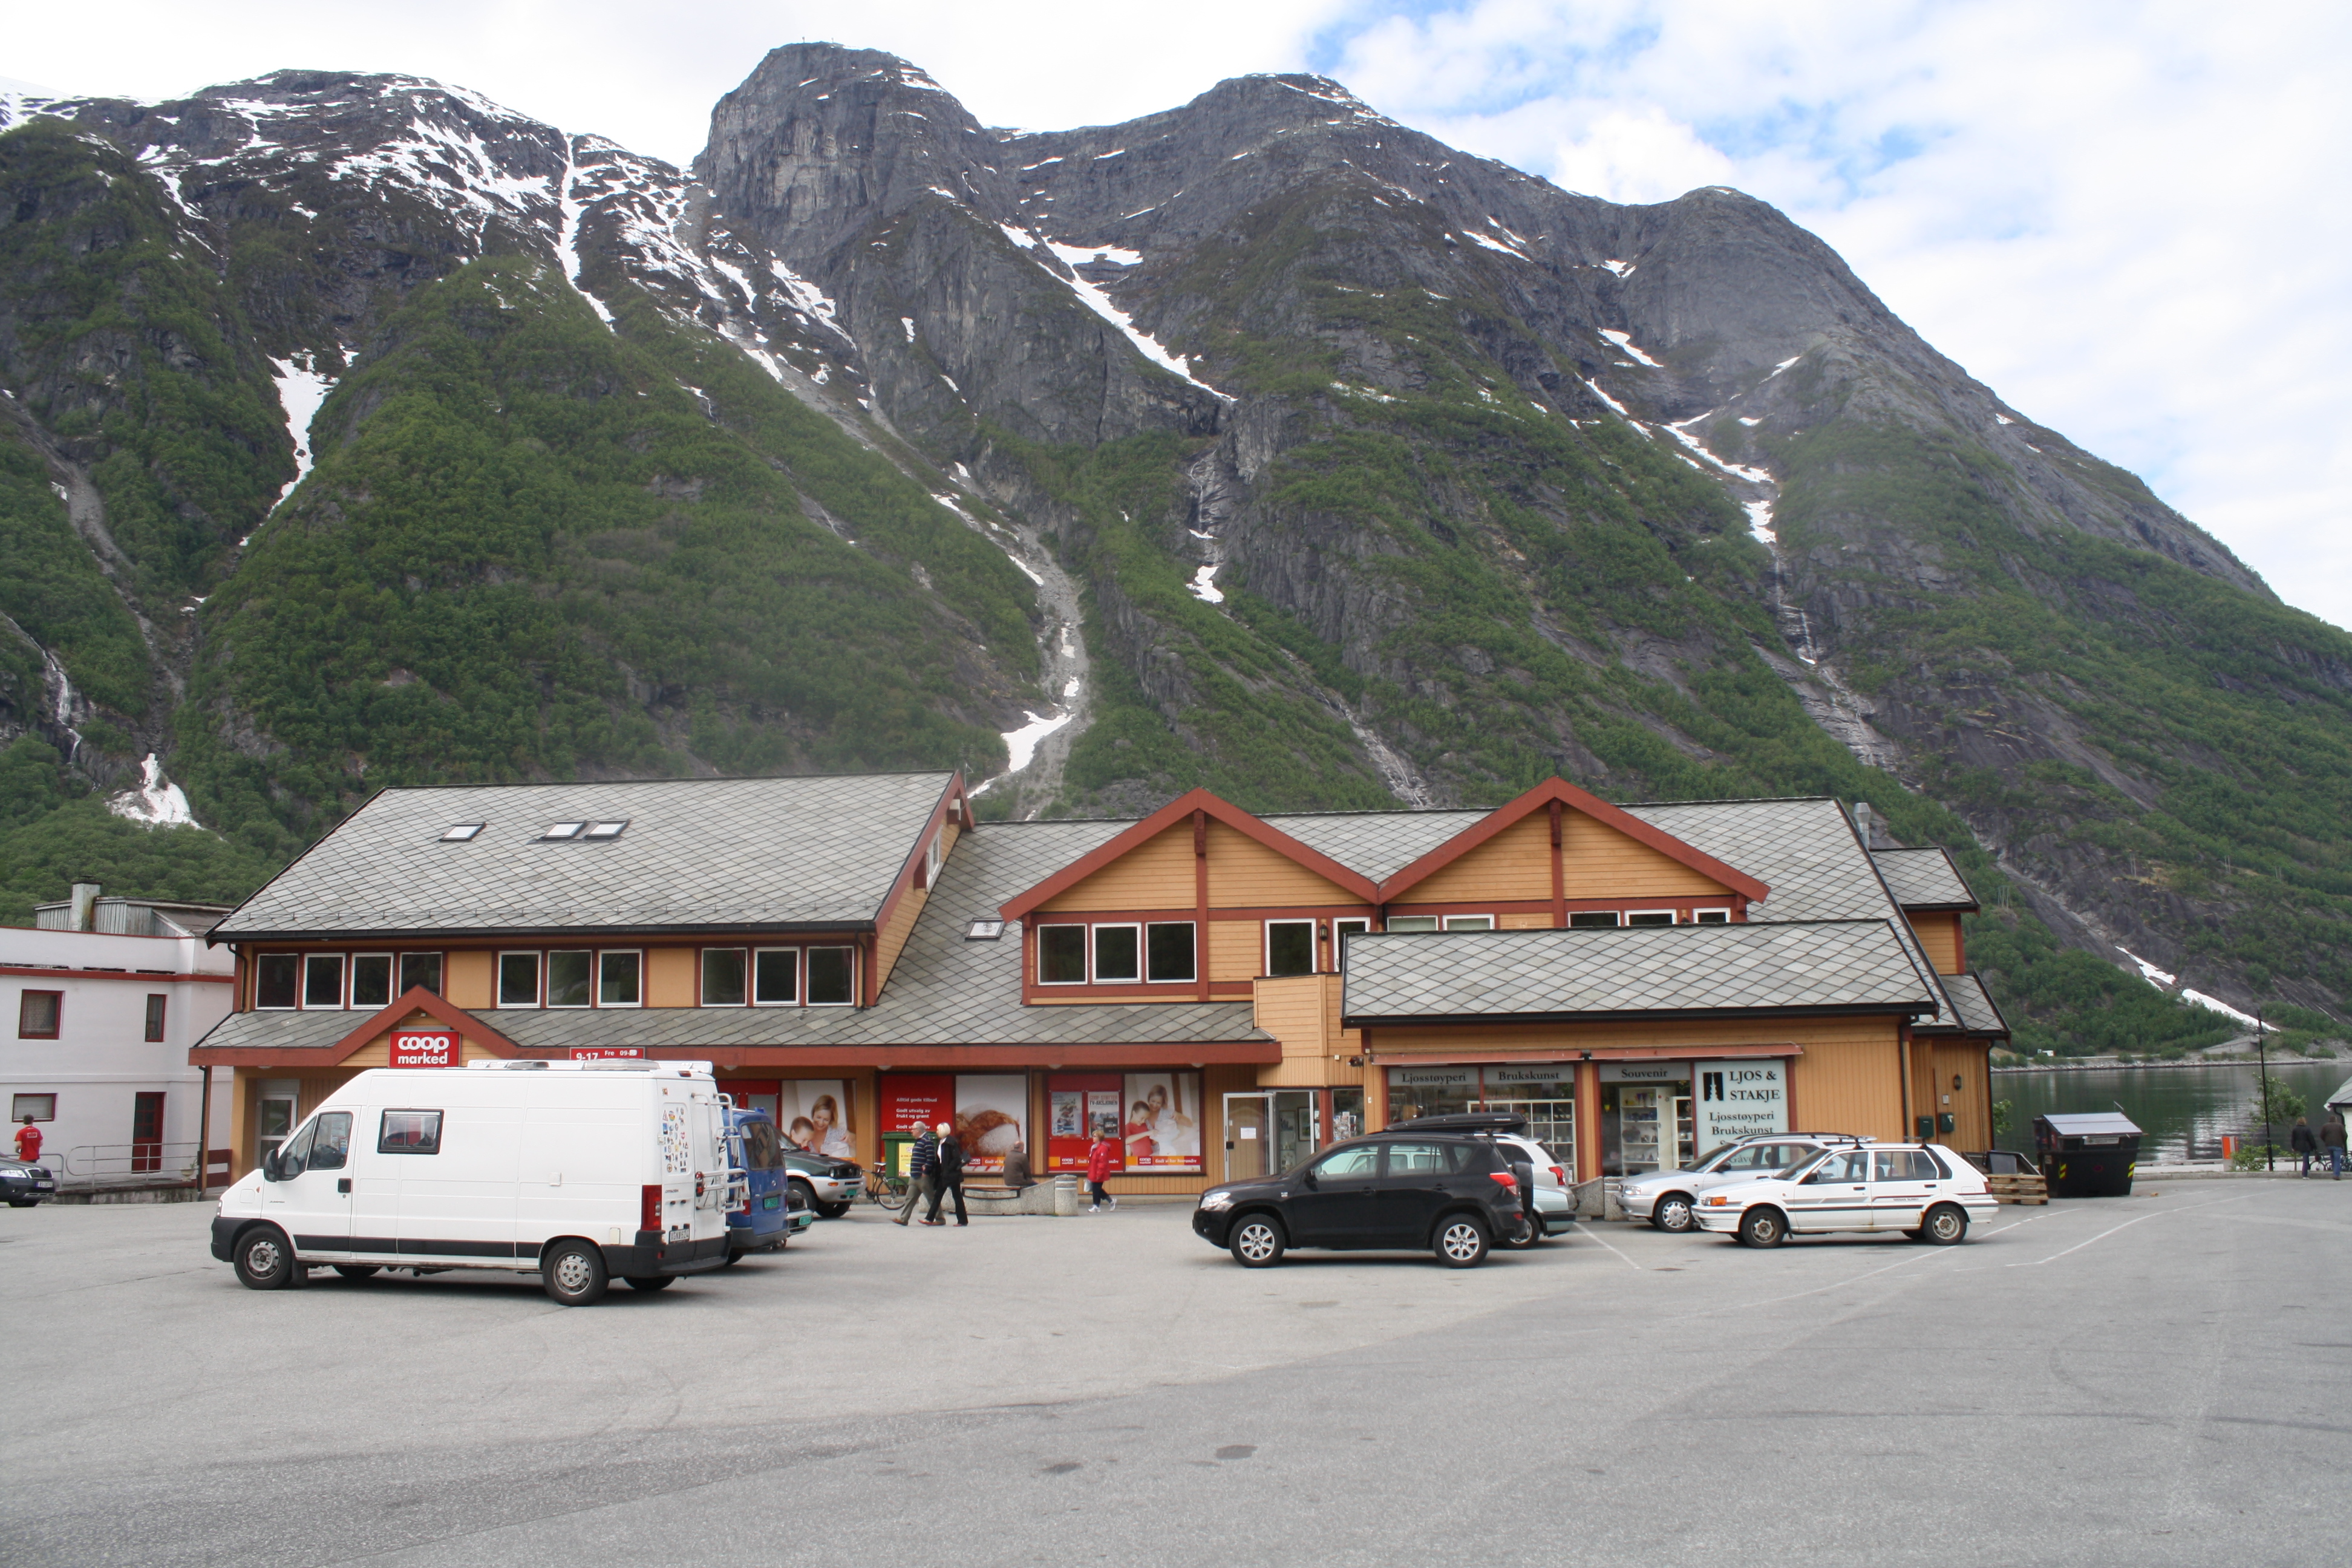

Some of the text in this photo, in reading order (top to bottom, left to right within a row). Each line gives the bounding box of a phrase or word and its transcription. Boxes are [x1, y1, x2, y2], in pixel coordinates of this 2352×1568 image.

[397, 1036, 449, 1053] coop
[397, 1051, 448, 1064] marked
[576, 1053, 598, 1061] 9-17
[1402, 1072, 1466, 1085] Ljosstøyperi
[1498, 1071, 1560, 1081] Brukskunst
[1621, 1068, 1668, 1078] Souvenir
[1729, 1071, 1777, 1084] LJOS &
[1730, 1089, 1781, 1103] STAKJE
[1709, 1111, 1774, 1123] Ljosstøyperi
[1711, 1126, 1774, 1135] Brukskunst
